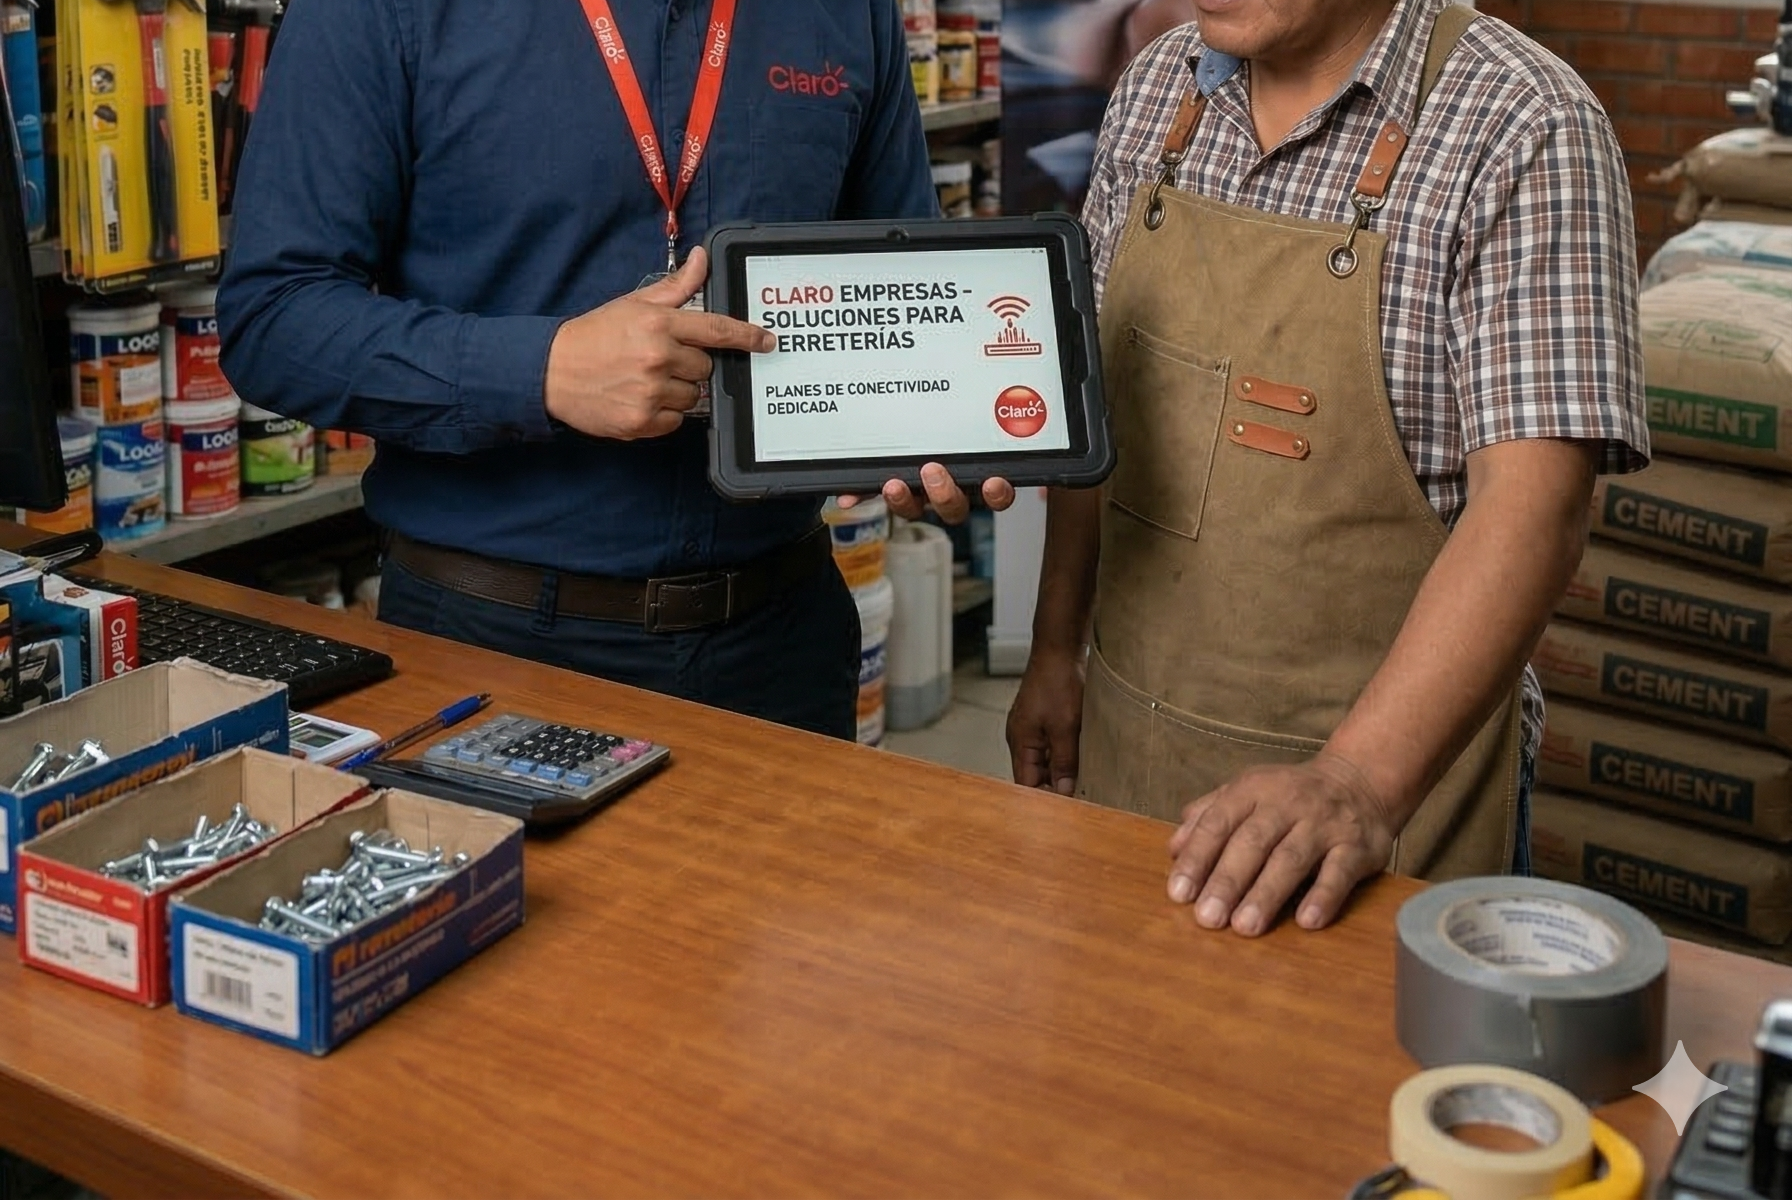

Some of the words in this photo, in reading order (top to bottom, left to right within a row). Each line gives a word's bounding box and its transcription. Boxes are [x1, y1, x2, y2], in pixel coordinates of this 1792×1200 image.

[708, 25, 727, 67] Claro
[768, 63, 845, 97] Claro
[761, 285, 834, 305] CLARO
[840, 282, 958, 303] EMPRESAS
[762, 307, 900, 330] SOLUCIONES
[906, 305, 964, 325] PARA
[777, 327, 915, 353] ERRETERÍAS
[766, 383, 822, 398] PLANES
[826, 383, 844, 397] DE
[847, 379, 950, 395] CONECTIVIDAD
[767, 401, 838, 415] DEDICADA
[998, 402, 1041, 419] Claro
[1647, 396, 1765, 439] EMENT
[1614, 496, 1753, 554] CEMENT
[1615, 588, 1756, 642] CEMENT
[110, 618, 129, 674] Claro
[1613, 665, 1754, 721] CEMENT
[1600, 752, 1741, 811] CEMENT
[1593, 854, 1735, 914] CEMENT
